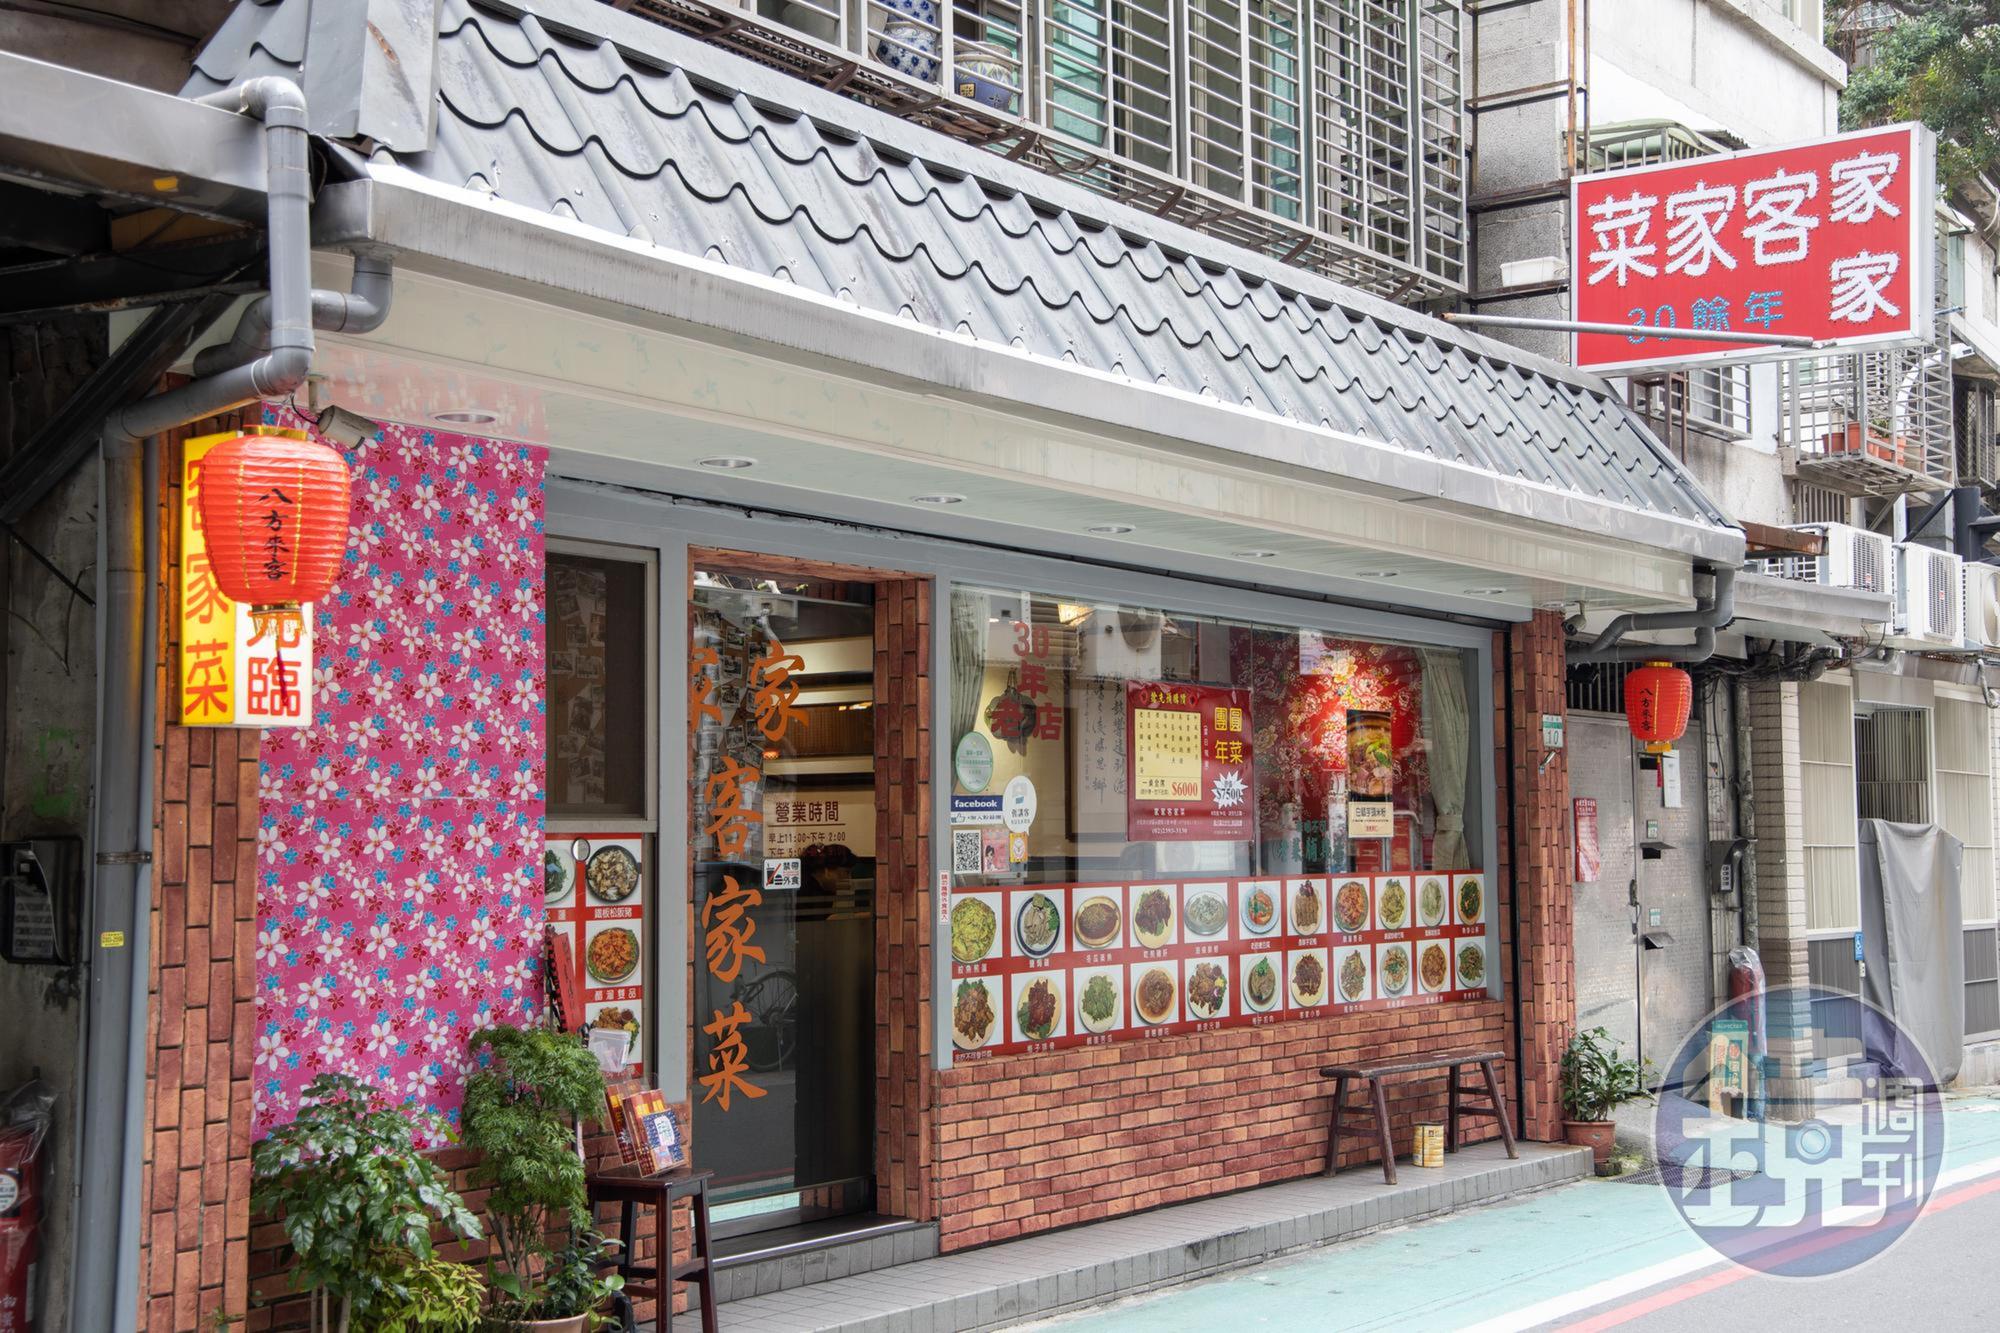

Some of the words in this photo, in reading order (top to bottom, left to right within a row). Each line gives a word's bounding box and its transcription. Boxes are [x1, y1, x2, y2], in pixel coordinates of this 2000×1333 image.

[258, 487, 294, 582] 八方來客
[1012, 620, 1050, 661] 30
[990, 697, 1063, 741] 老店
[1547, 729, 1560, 745] 10
[1214, 739, 1244, 765] 年菜
[1171, 781, 1198, 797] $6000
[775, 800, 839, 823] 營業時間
[954, 799, 998, 809] facebook
